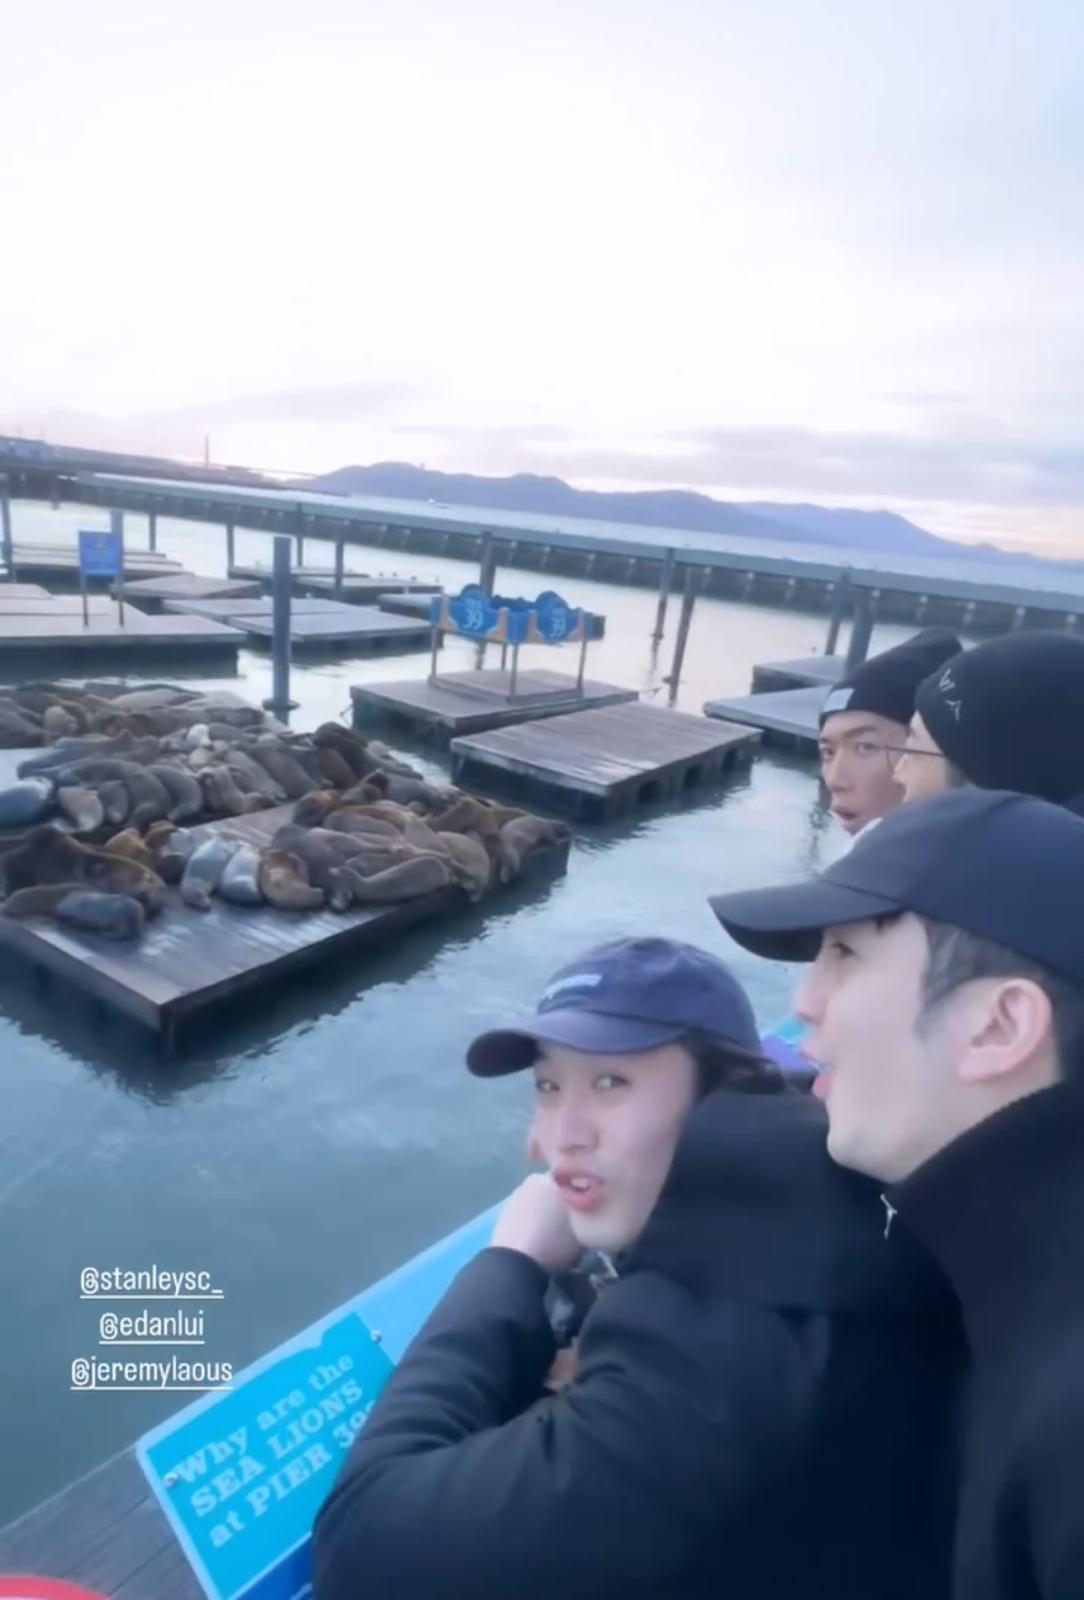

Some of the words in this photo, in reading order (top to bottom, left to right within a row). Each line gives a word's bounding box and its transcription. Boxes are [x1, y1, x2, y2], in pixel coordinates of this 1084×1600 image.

[464, 609, 483, 630] 39
[176, 1426, 248, 1483] Why
[256, 1389, 305, 1431] are
[308, 1355, 354, 1391] the
[190, 1456, 267, 1518] SEA
[266, 1378, 363, 1460] LIONS
[209, 1511, 246, 1548] at
[247, 1443, 333, 1517] PIER
